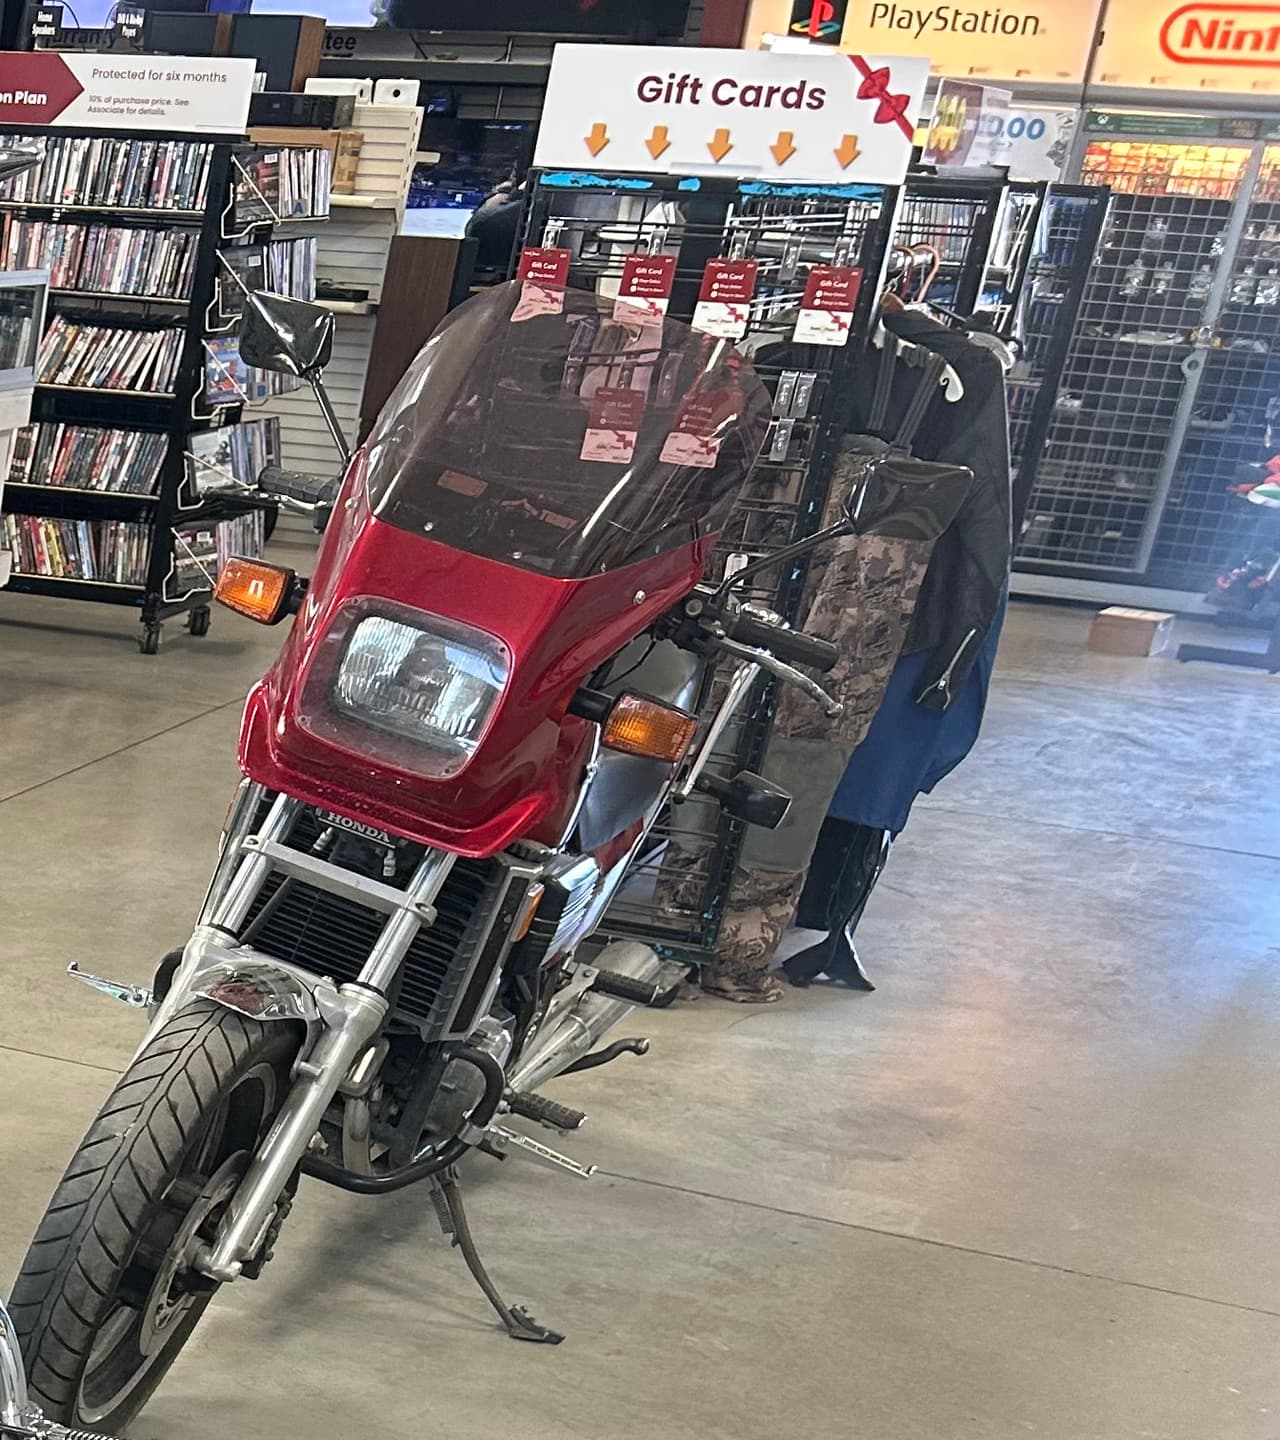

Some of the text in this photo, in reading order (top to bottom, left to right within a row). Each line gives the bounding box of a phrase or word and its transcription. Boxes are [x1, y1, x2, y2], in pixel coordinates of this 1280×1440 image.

[870, 2, 1040, 39] PlayStation
[92, 68, 227, 83] Protected for six months
[14, 91, 48, 105] Plan
[637, 73, 827, 110] Gift Cards
[112, 96, 150, 105] purchase
[87, 105, 125, 114] Associate
[126, 106, 137, 115] for
[294, 201, 305, 213] A
[327, 811, 391, 843] HONDA
